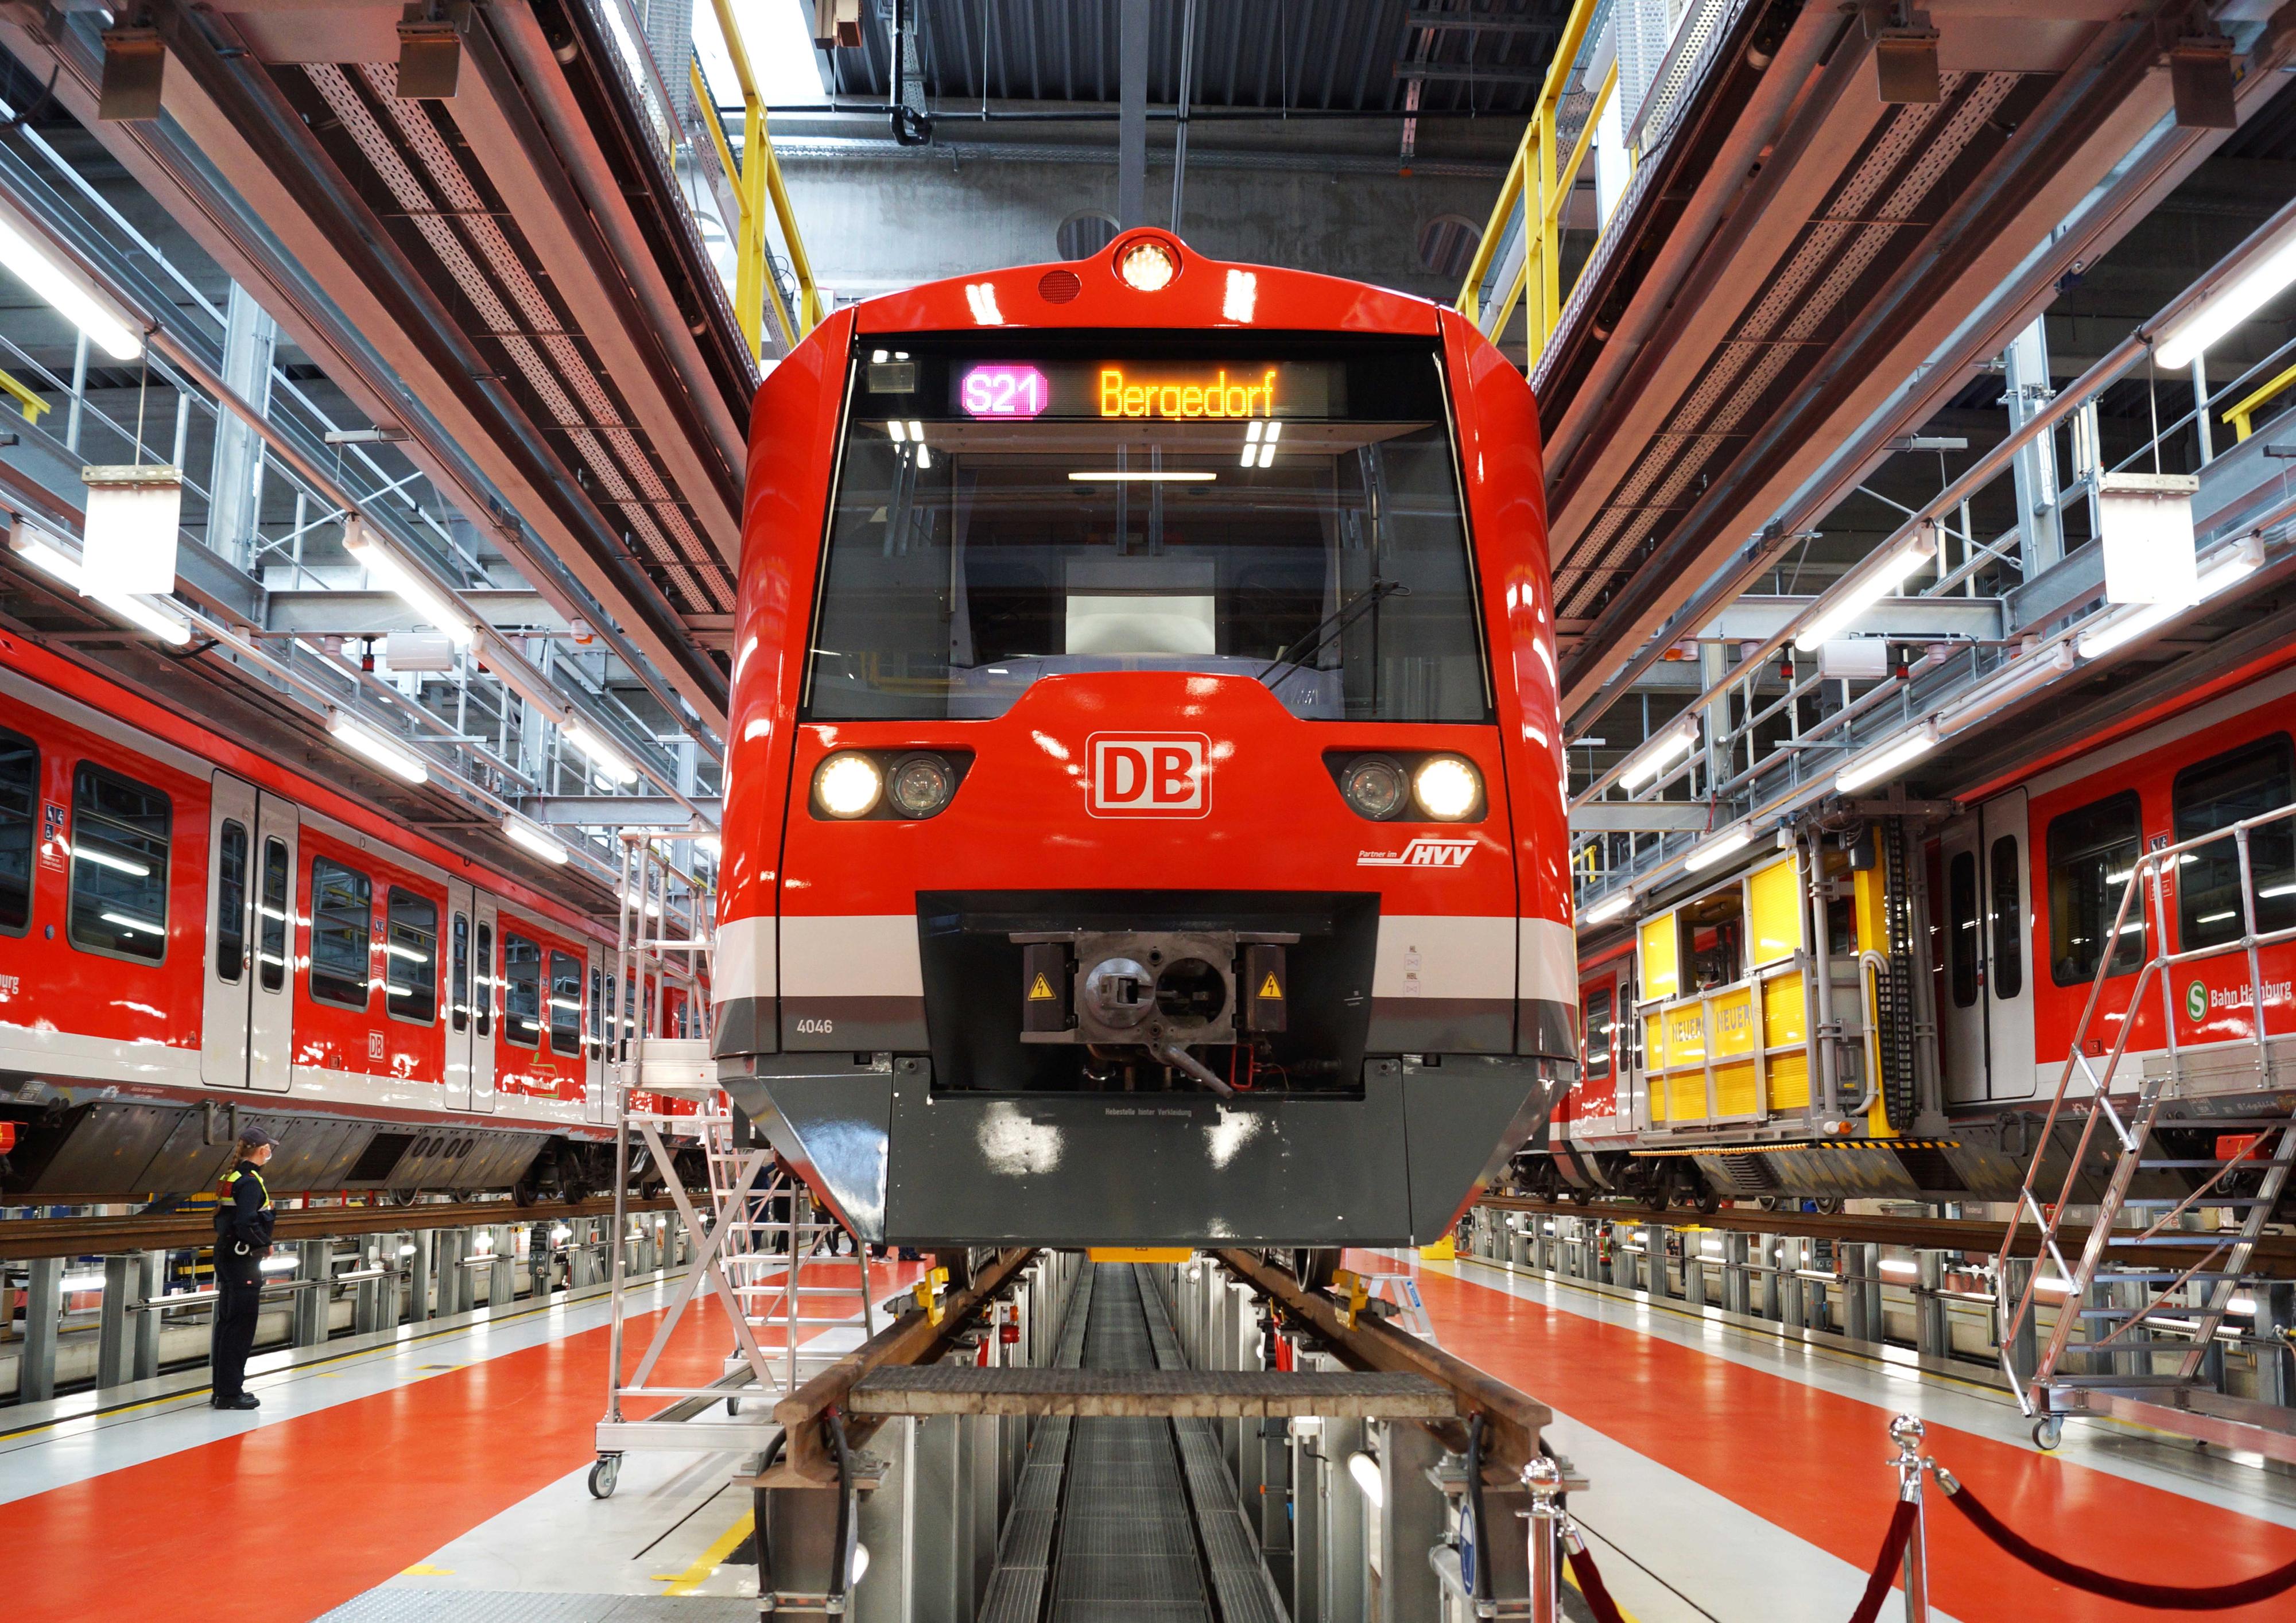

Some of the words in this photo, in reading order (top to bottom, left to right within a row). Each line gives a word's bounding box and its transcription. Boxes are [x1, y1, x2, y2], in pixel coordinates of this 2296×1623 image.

[966, 374, 1037, 412] S21
[1101, 371, 1275, 421] Bergedorf
[1103, 747, 1195, 803] DB
[1411, 845, 1473, 865] HVV
[0, 973, 20, 995] urg
[2190, 985, 2205, 1018] S
[2210, 987, 2237, 1007] Bahn
[797, 1019, 833, 1033] 4046
[1671, 1016, 1705, 1044] NEUER
[1716, 1004, 1754, 1034] NEUER
[370, 1035, 382, 1057] DB
